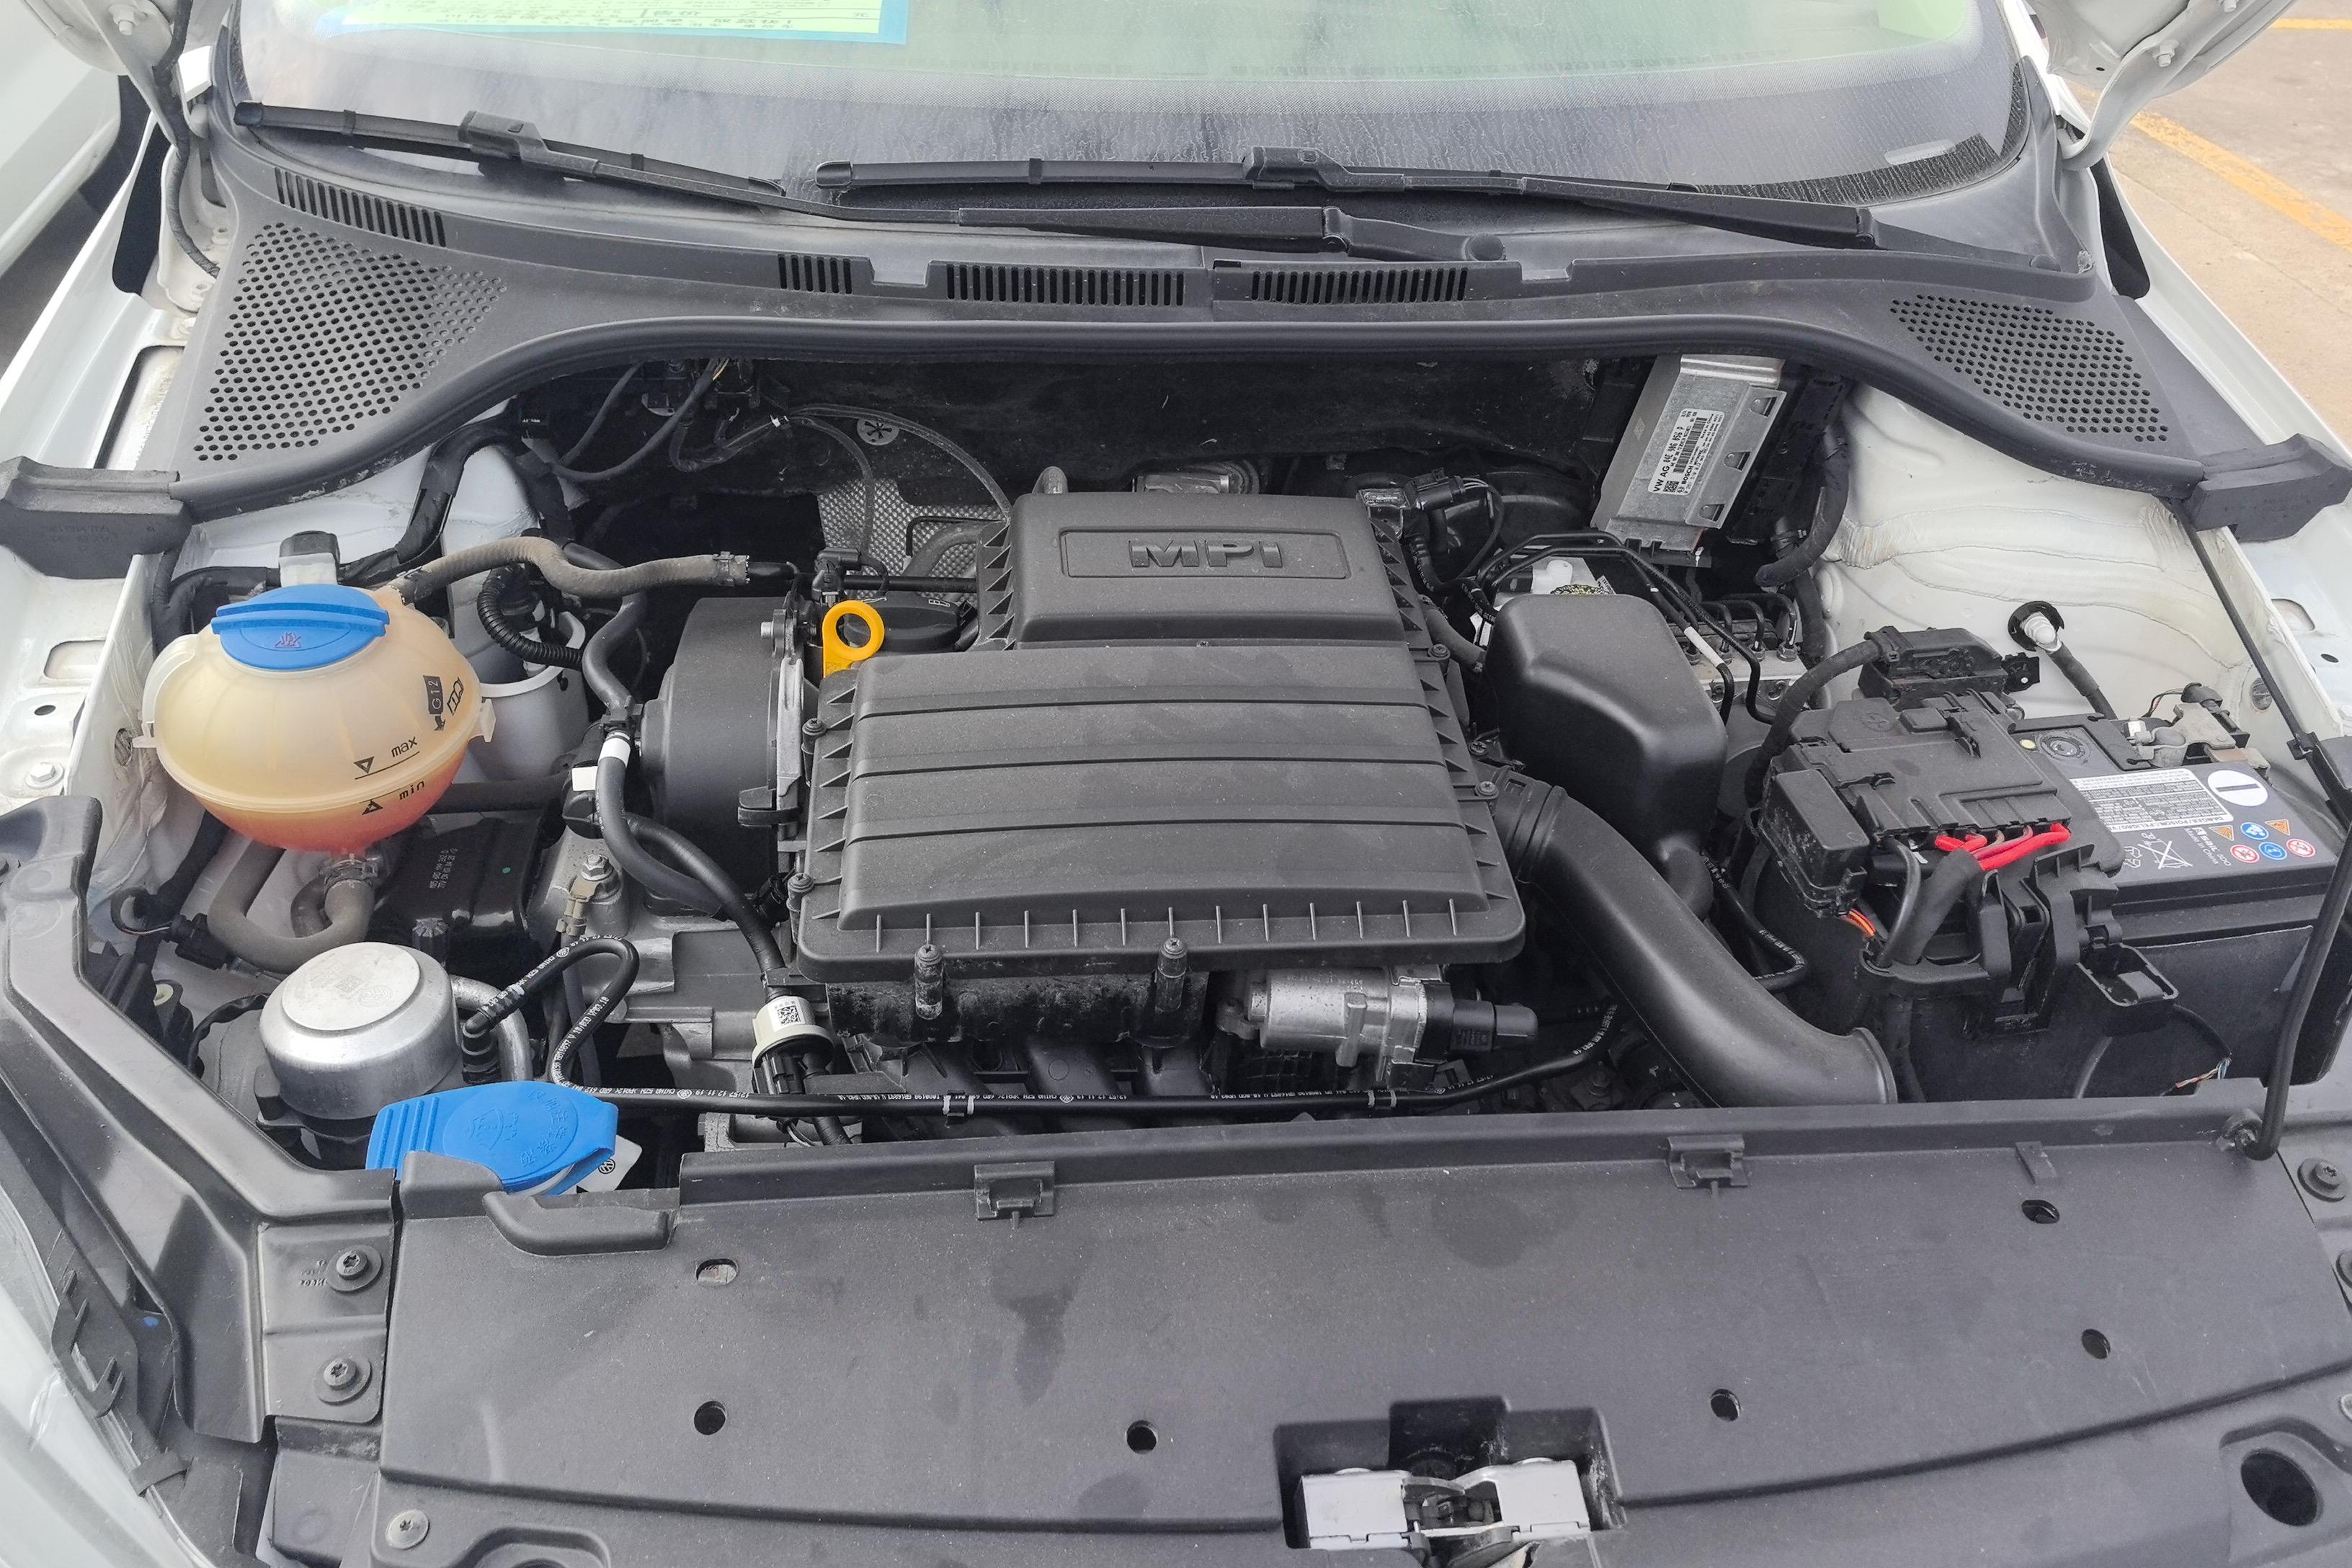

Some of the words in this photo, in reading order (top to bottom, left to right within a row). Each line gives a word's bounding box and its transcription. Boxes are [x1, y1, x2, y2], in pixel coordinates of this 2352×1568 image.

[1652, 478, 1664, 492] VW
[1660, 466, 1670, 477] AG
[1681, 466, 1693, 484] BOSCH
[1128, 540, 1283, 568] MPI
[428, 680, 442, 710] G12
[391, 736, 417, 757] max
[399, 780, 424, 800] min
[2141, 832, 2156, 840] Pb
[2183, 827, 2199, 843] Made
[2203, 848, 2219, 865] China
